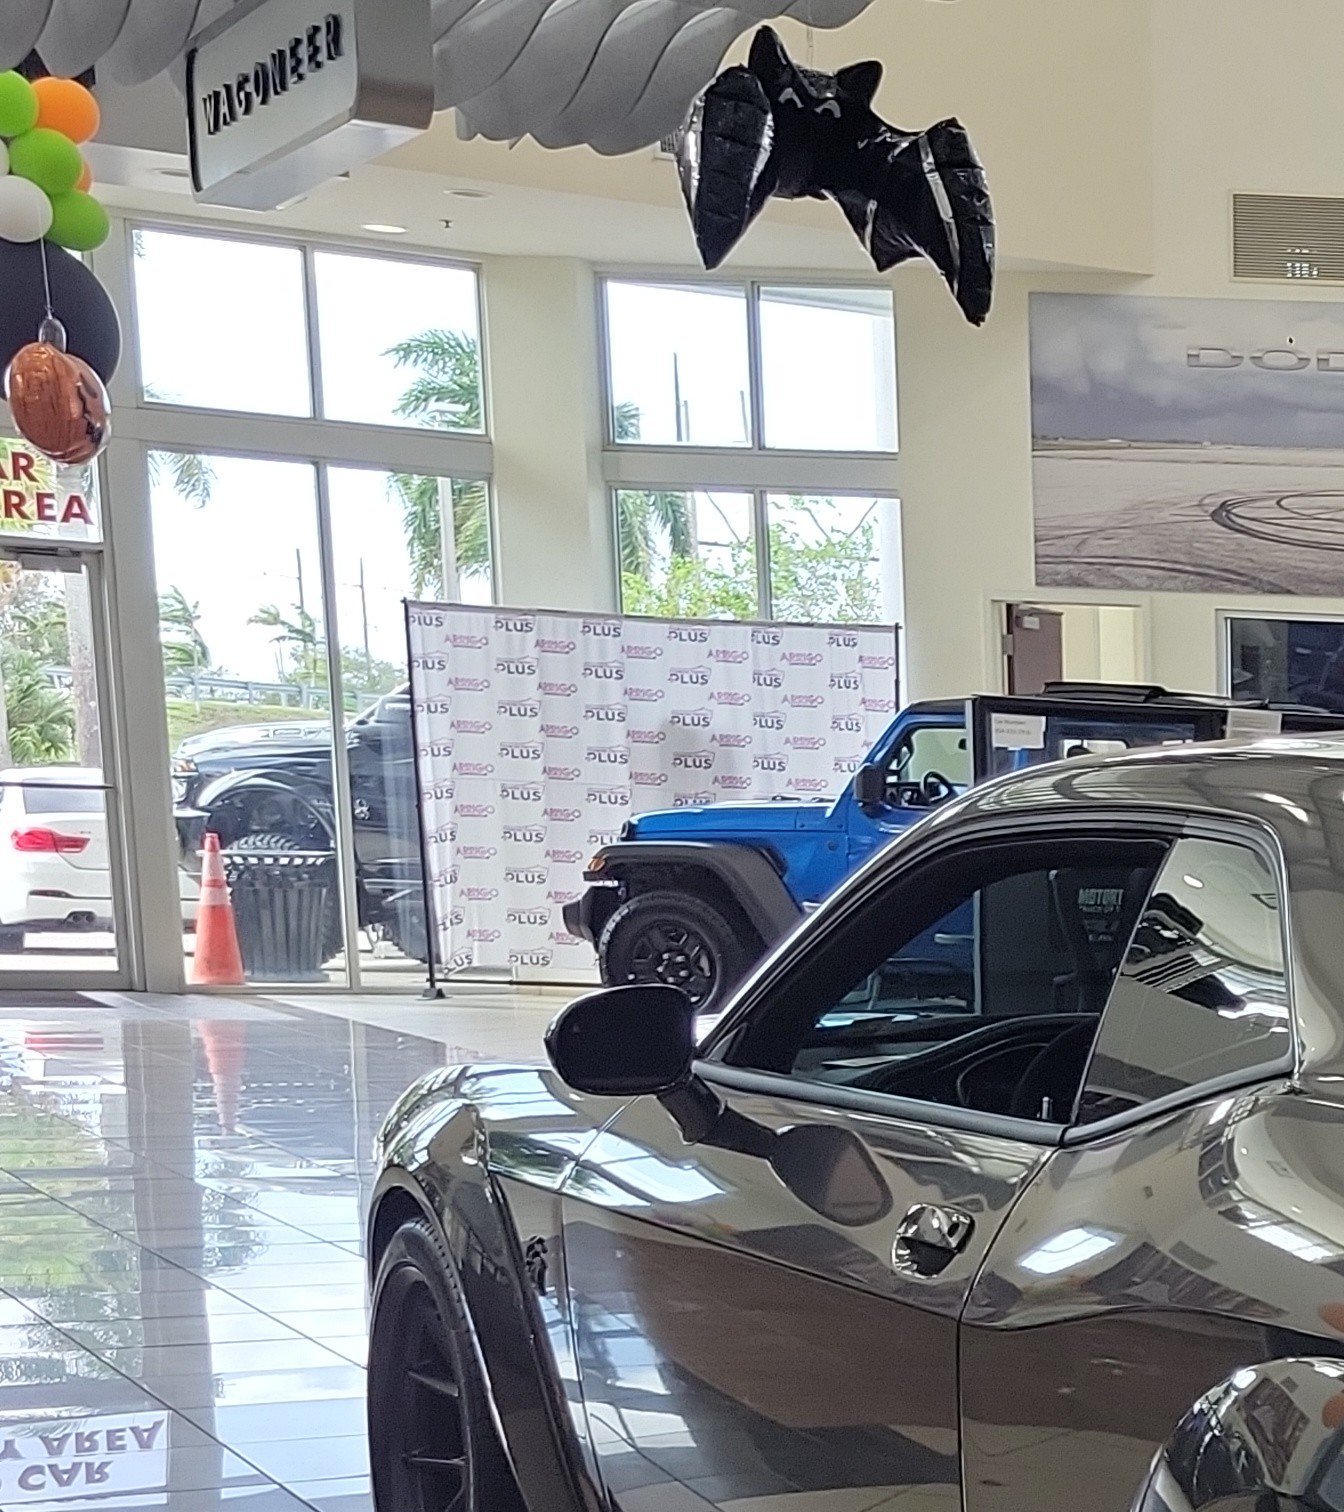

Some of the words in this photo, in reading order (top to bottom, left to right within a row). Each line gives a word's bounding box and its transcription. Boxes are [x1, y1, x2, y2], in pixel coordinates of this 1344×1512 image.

[202, 13, 344, 135] WAGONEER
[0, 451, 40, 482] R
[0, 489, 95, 525] REA
[494, 620, 534, 632] PLUS
[580, 625, 621, 637] PLUS
[668, 631, 708, 642] PLUS
[827, 637, 858, 648] PLUS
[495, 663, 536, 675] PLUS
[582, 667, 624, 680] PLUS
[668, 673, 709, 685] PLUS
[829, 679, 859, 690] PLUS
[497, 706, 539, 718] PLUS
[584, 710, 626, 722] PLUS
[670, 716, 711, 727] PLUS
[831, 721, 862, 732] PLUS
[499, 748, 541, 760] PLUS
[586, 752, 628, 764] PLUS
[672, 757, 713, 769] PLUS
[833, 763, 856, 773] PLU
[500, 789, 541, 801] PLUS
[586, 793, 629, 806] PLUS
[502, 831, 544, 843] PLUS
[504, 872, 547, 884] PLUS
[506, 914, 548, 925] PLUS
[508, 955, 550, 967] PLUS
